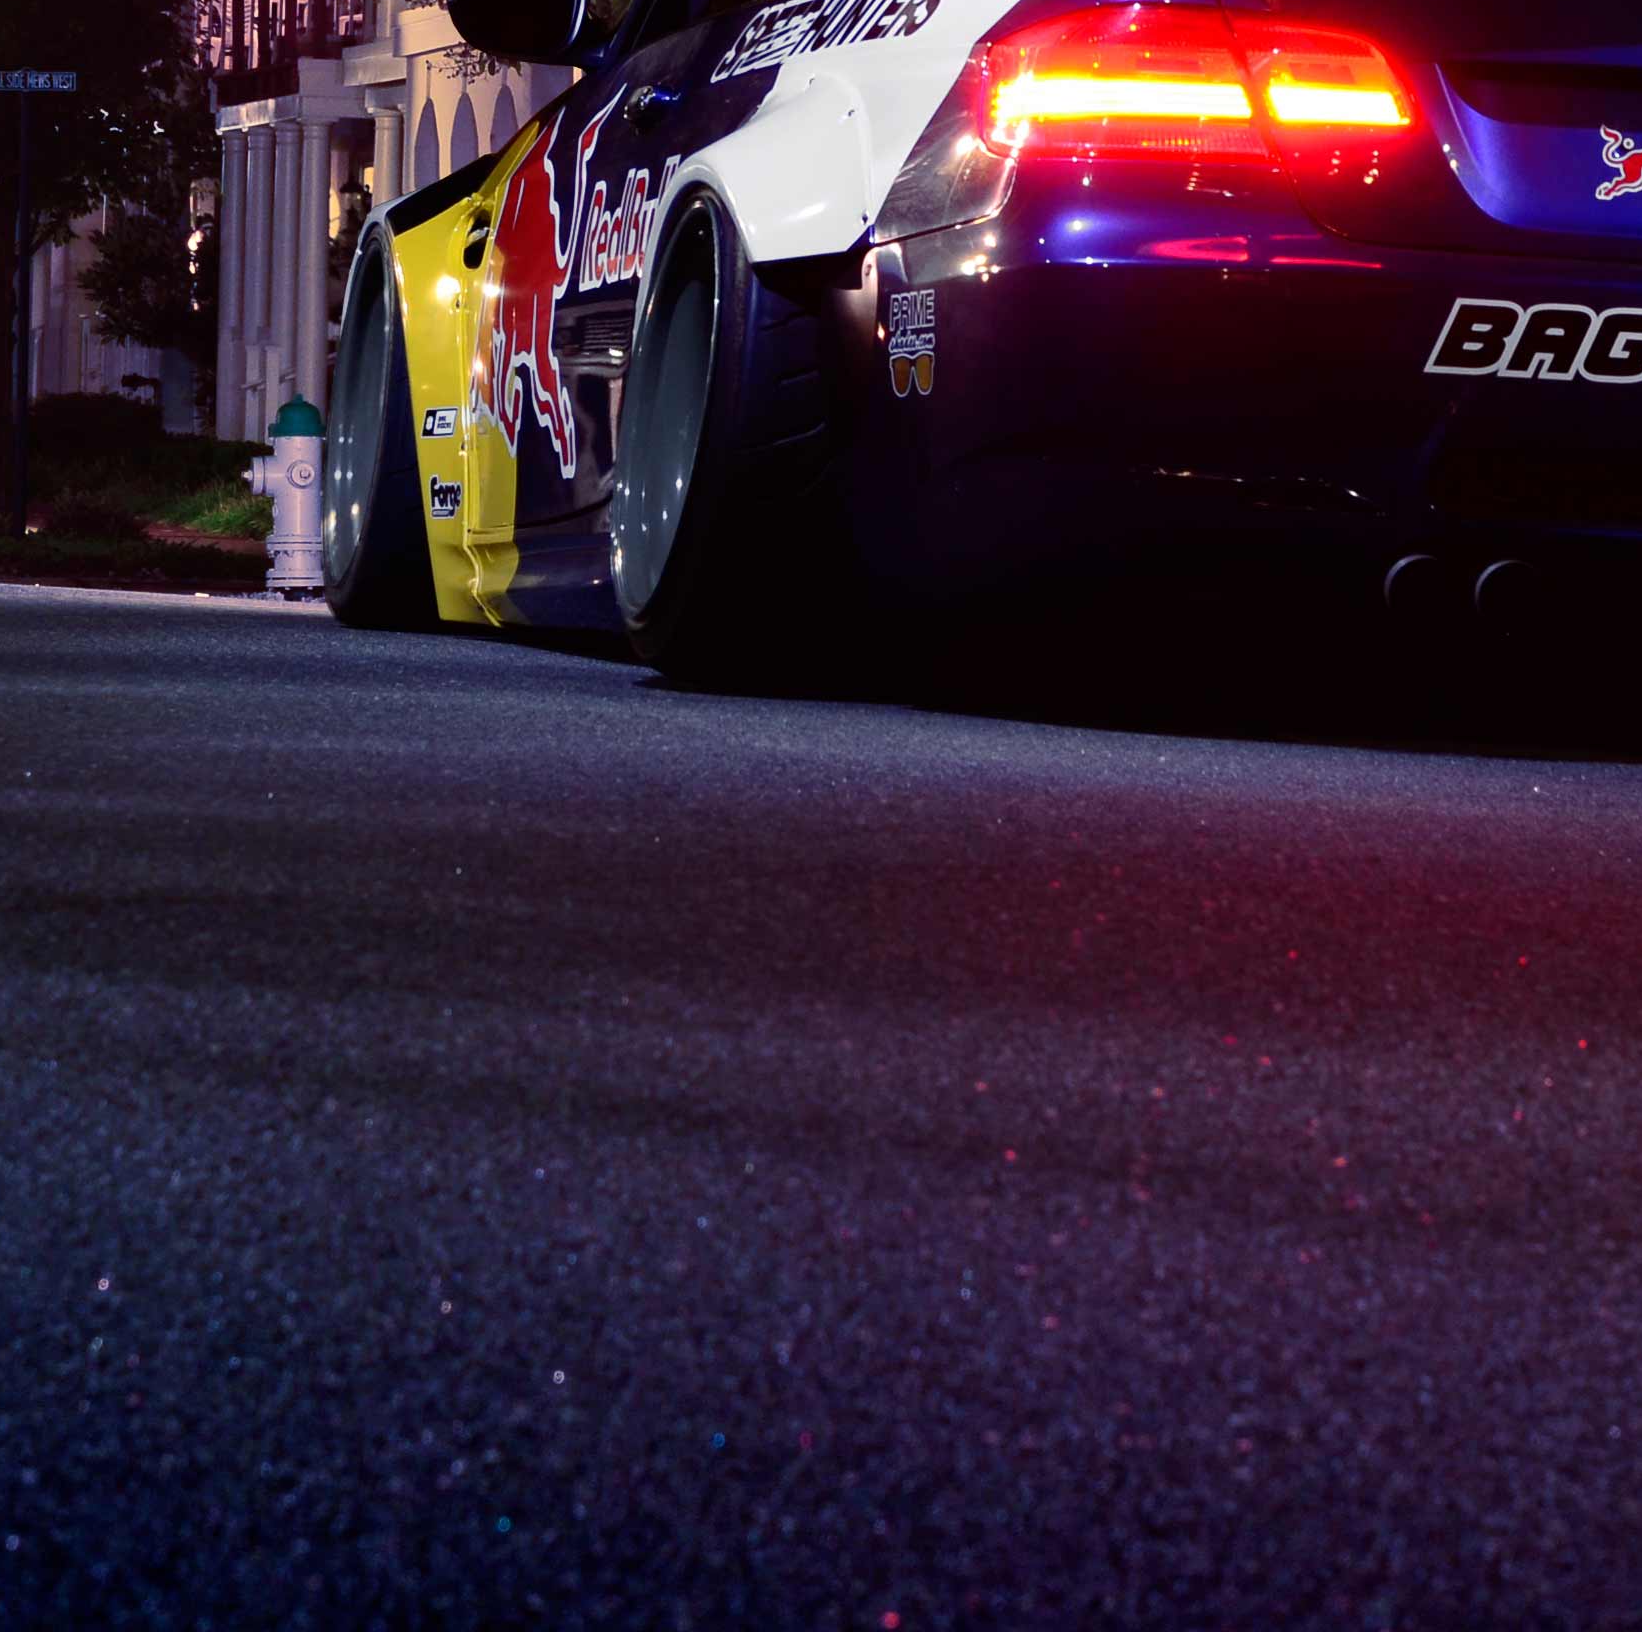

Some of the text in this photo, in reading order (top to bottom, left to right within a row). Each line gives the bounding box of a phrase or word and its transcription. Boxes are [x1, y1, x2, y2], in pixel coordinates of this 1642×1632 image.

[6, 72, 25, 89] SIDE
[52, 72, 74, 89] WEST
[889, 289, 935, 332] PRIME
